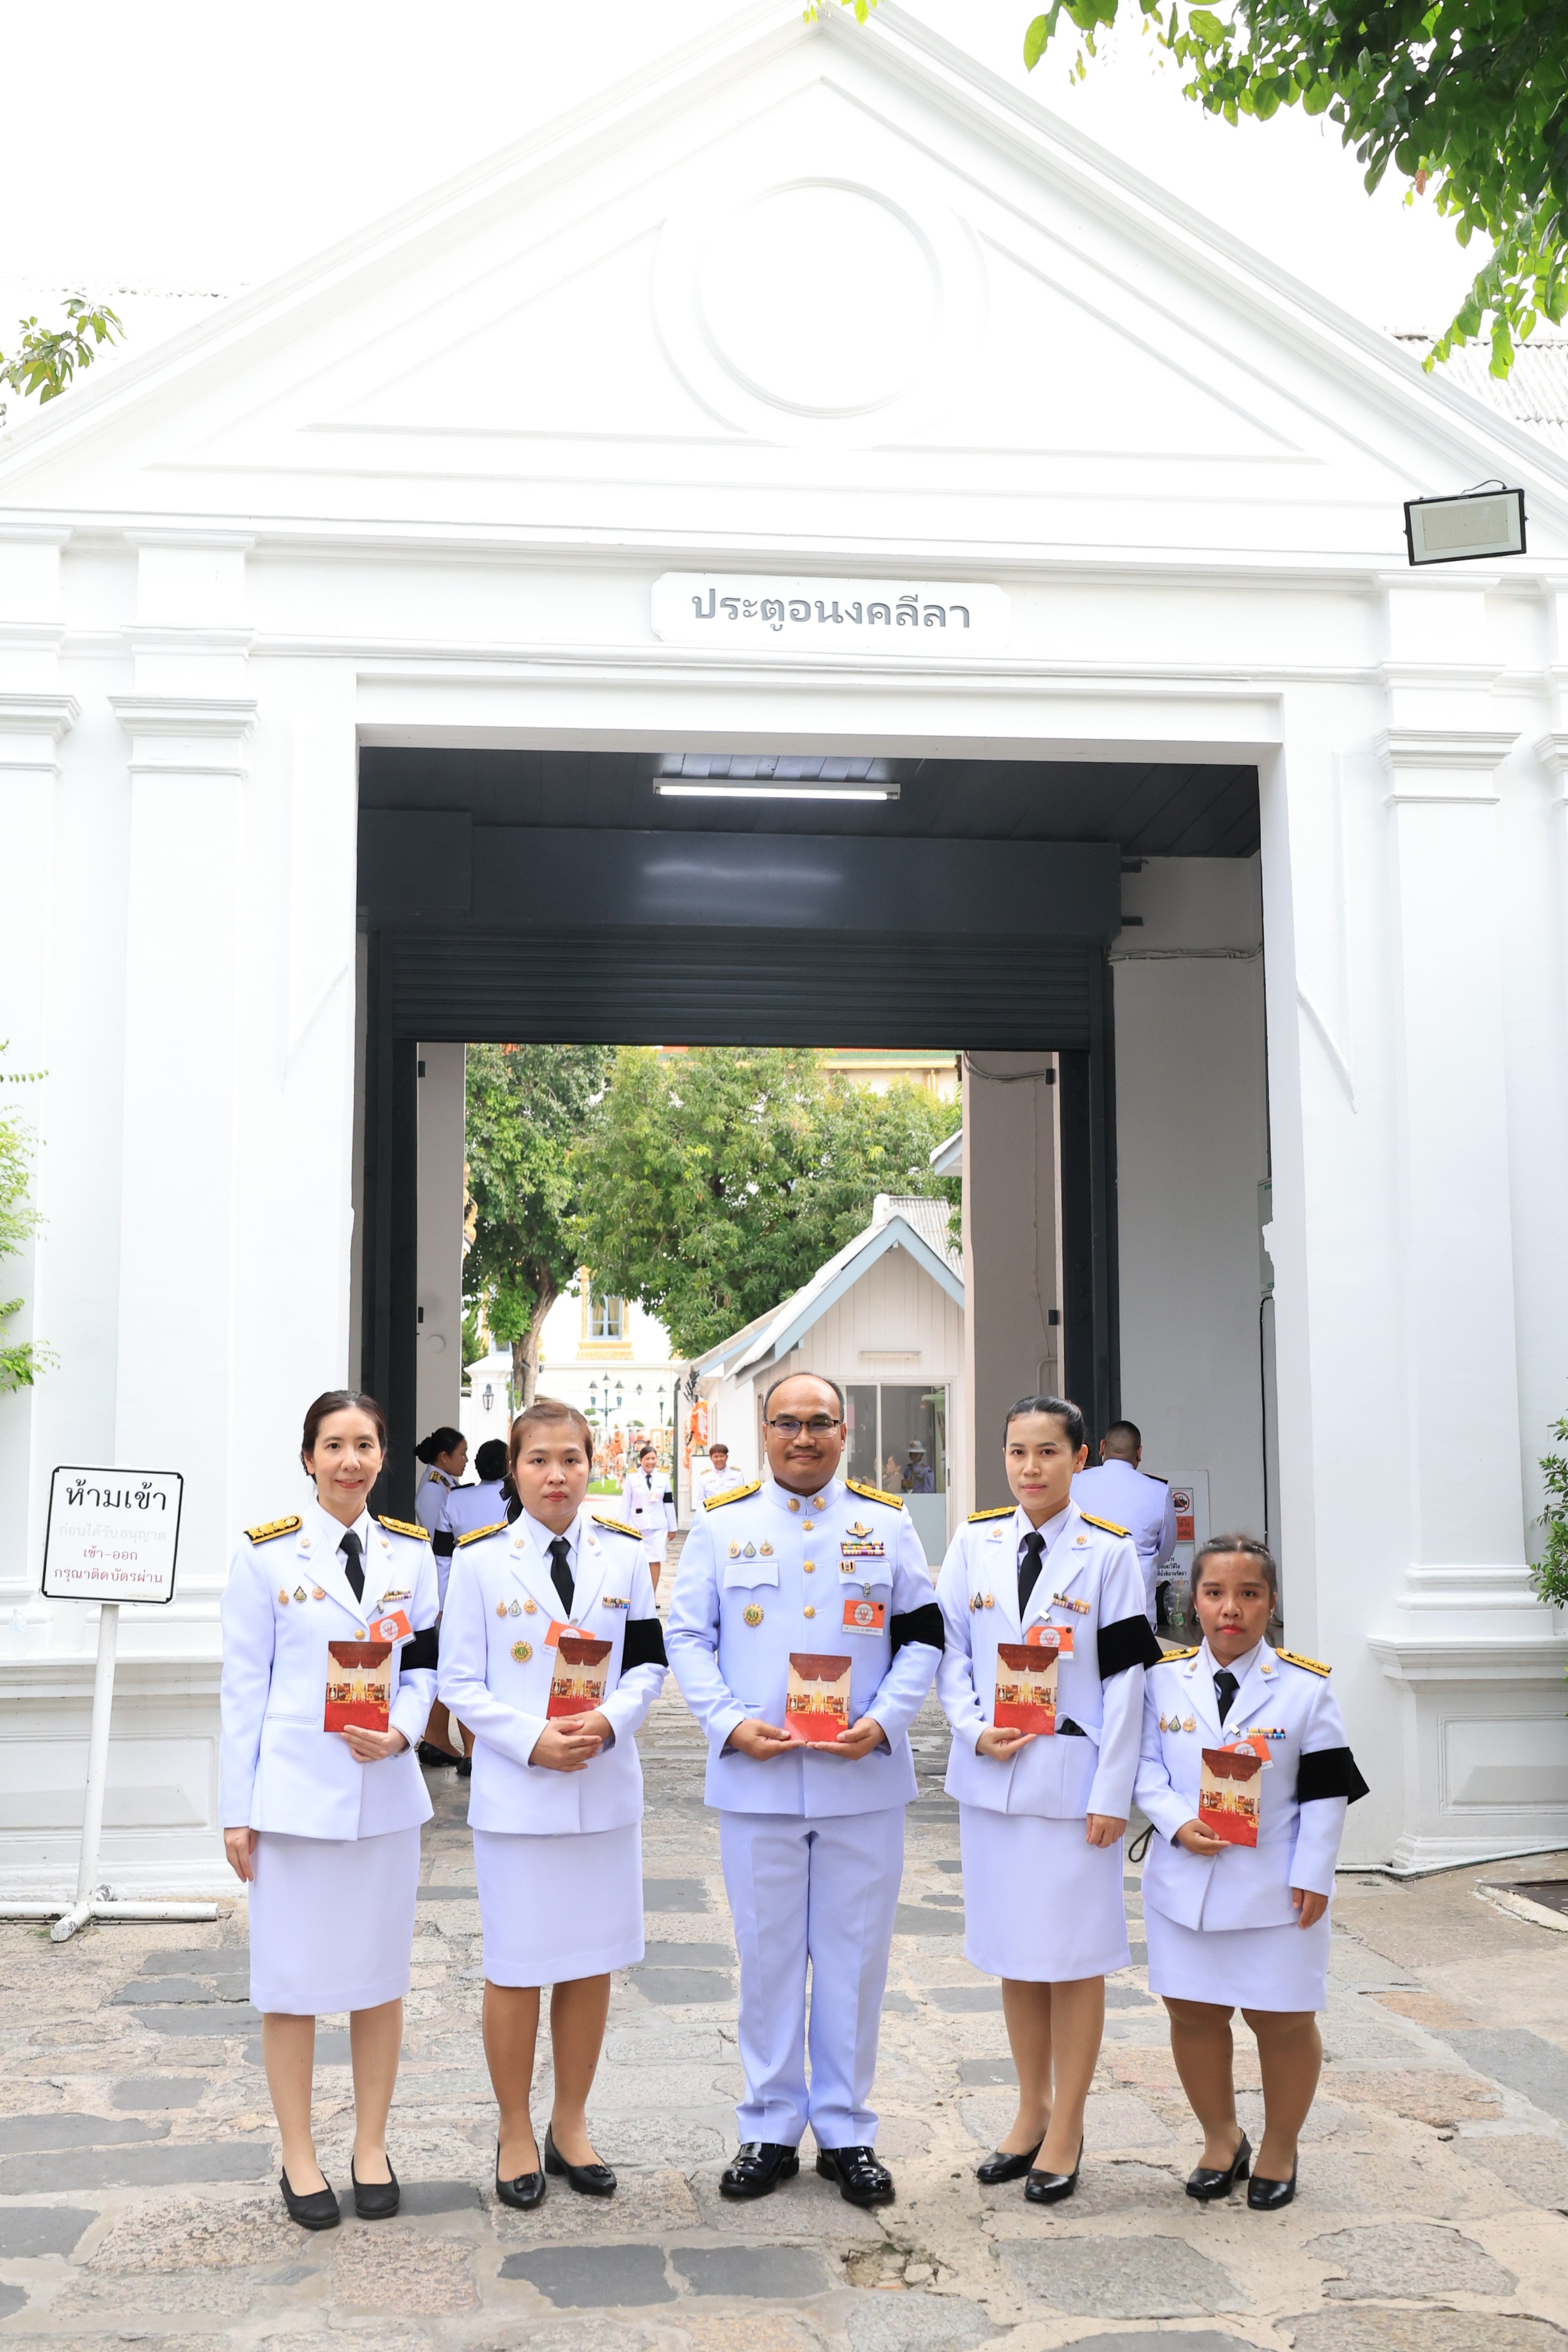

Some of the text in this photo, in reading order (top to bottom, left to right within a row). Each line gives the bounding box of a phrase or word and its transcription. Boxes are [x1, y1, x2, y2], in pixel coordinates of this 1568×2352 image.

[692, 589, 970, 632] ประตูอนงคลีลา
[66, 1479, 166, 1511] ห้ามเข้า
[83, 1545, 138, 1560] เข้า-ออก
[55, 1568, 163, 1583] กรุณาติดบัตรผ่าน
